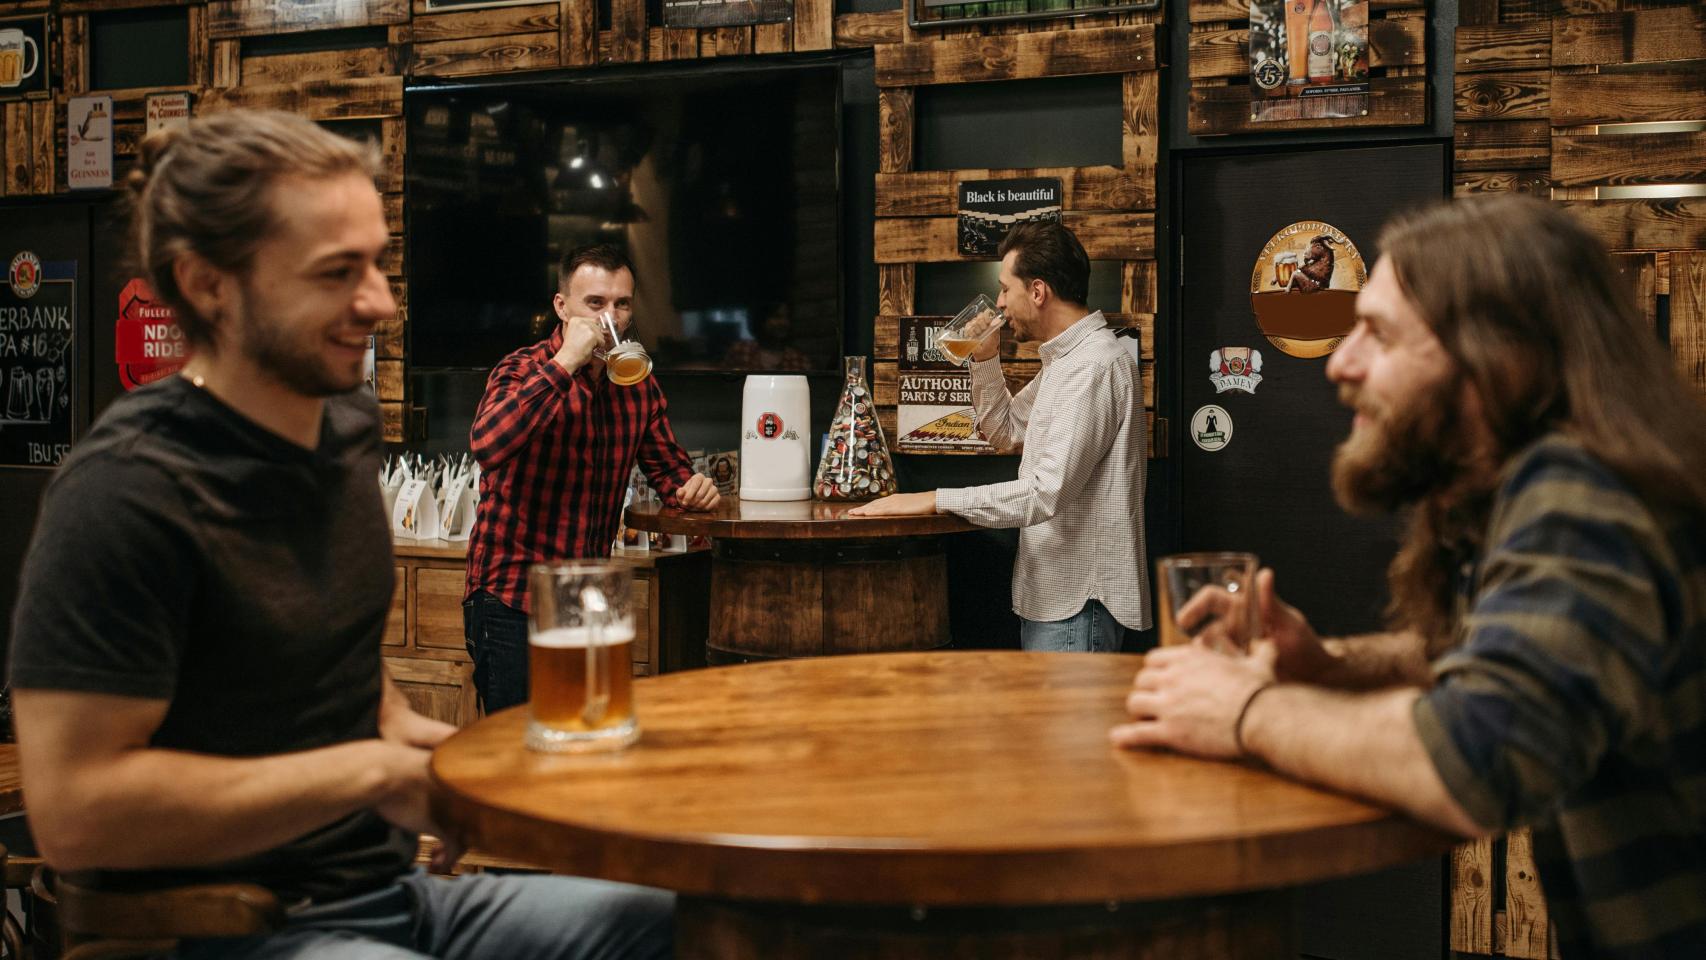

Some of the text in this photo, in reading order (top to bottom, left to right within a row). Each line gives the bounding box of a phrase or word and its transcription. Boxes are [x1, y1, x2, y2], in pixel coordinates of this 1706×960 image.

[966, 188, 1054, 203] Black is beautiful
[1220, 377, 1252, 389] DAMEN
[901, 391, 935, 402] PARTS
[938, 391, 947, 402] &
[935, 419, 970, 429] Indian
[28, 442, 51, 464] IBU
